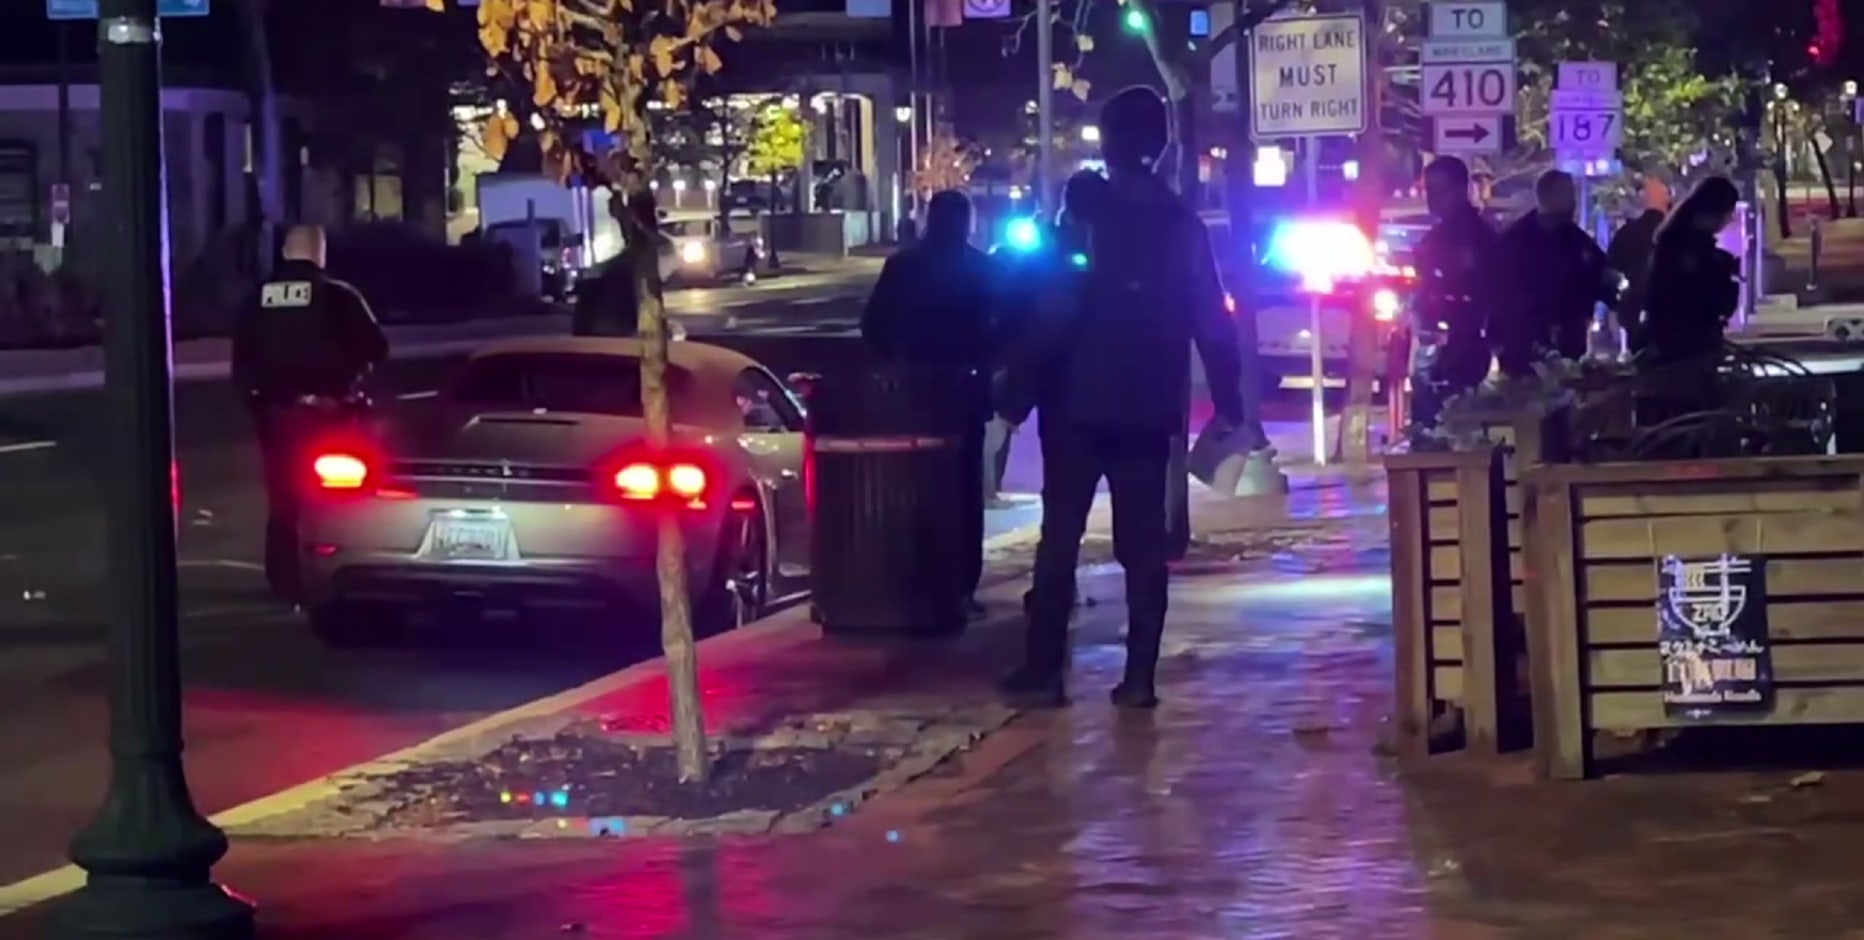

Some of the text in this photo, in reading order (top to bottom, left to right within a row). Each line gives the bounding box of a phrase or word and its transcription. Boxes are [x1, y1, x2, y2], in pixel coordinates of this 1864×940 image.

[1451, 8, 1484, 29] TO
[1258, 30, 1355, 52] RIGHT LANE
[1279, 64, 1338, 88] MUST
[1576, 70, 1601, 84] TO
[1430, 69, 1505, 107] 410
[1260, 99, 1358, 120] TURN RIGHT
[1558, 114, 1615, 141] 187
[261, 280, 312, 307] POLICE
